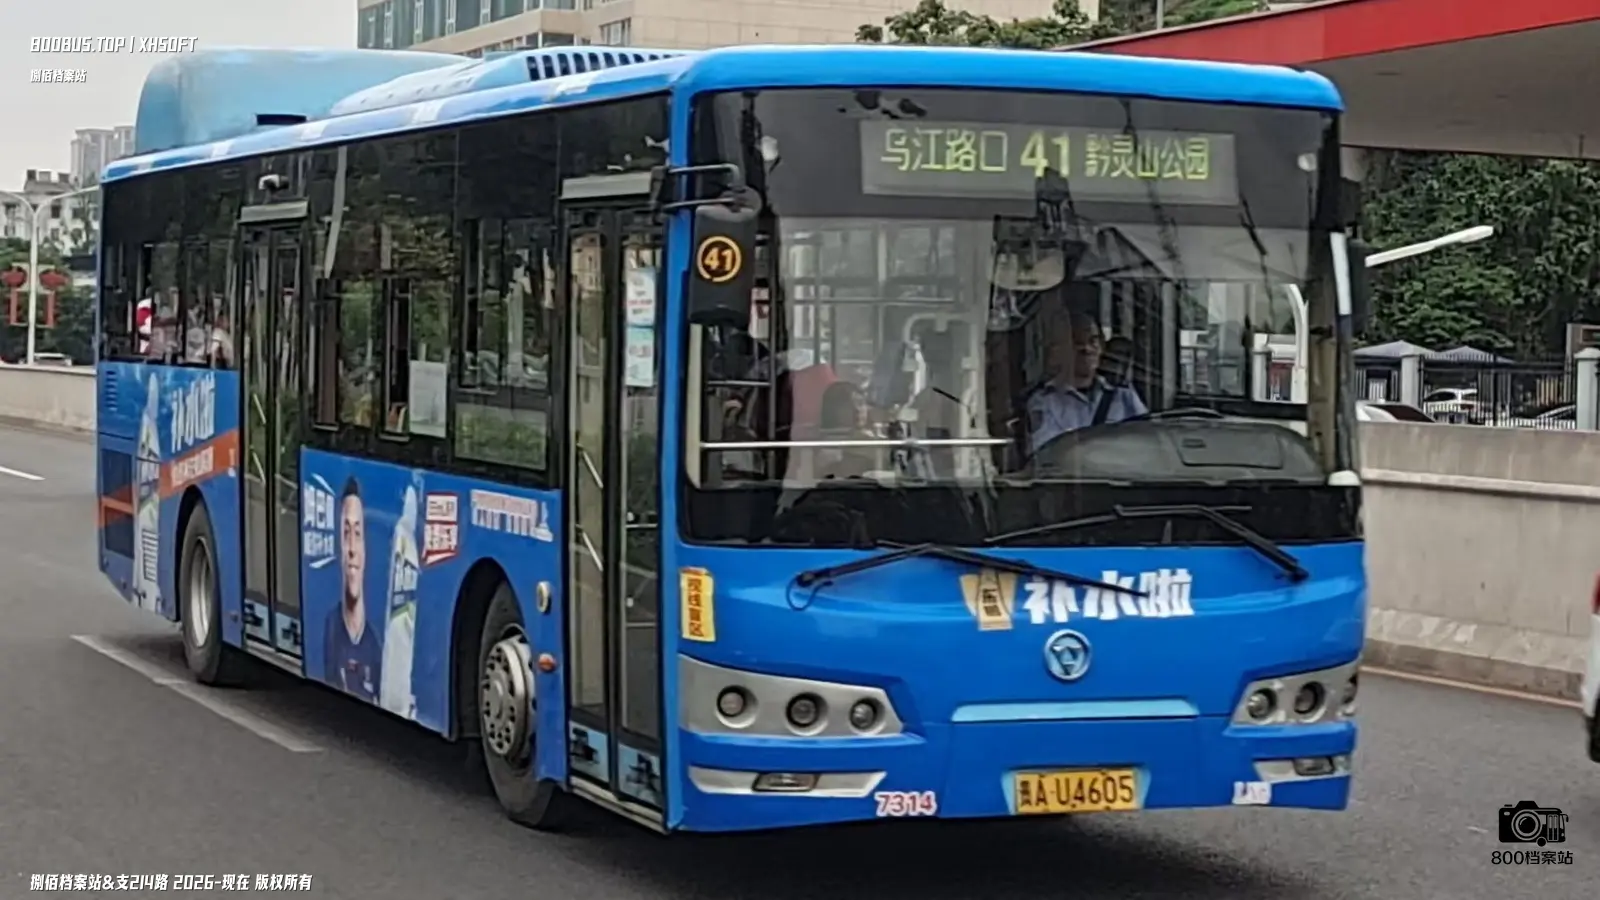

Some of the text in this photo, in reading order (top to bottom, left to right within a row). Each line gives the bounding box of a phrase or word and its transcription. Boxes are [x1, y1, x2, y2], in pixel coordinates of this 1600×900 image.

[881, 128, 1209, 180] 乌江路口 41 黔灵山公园
[704, 246, 735, 272] 41
[1023, 568, 1195, 624] 补水啦
[876, 790, 937, 816] 7314
